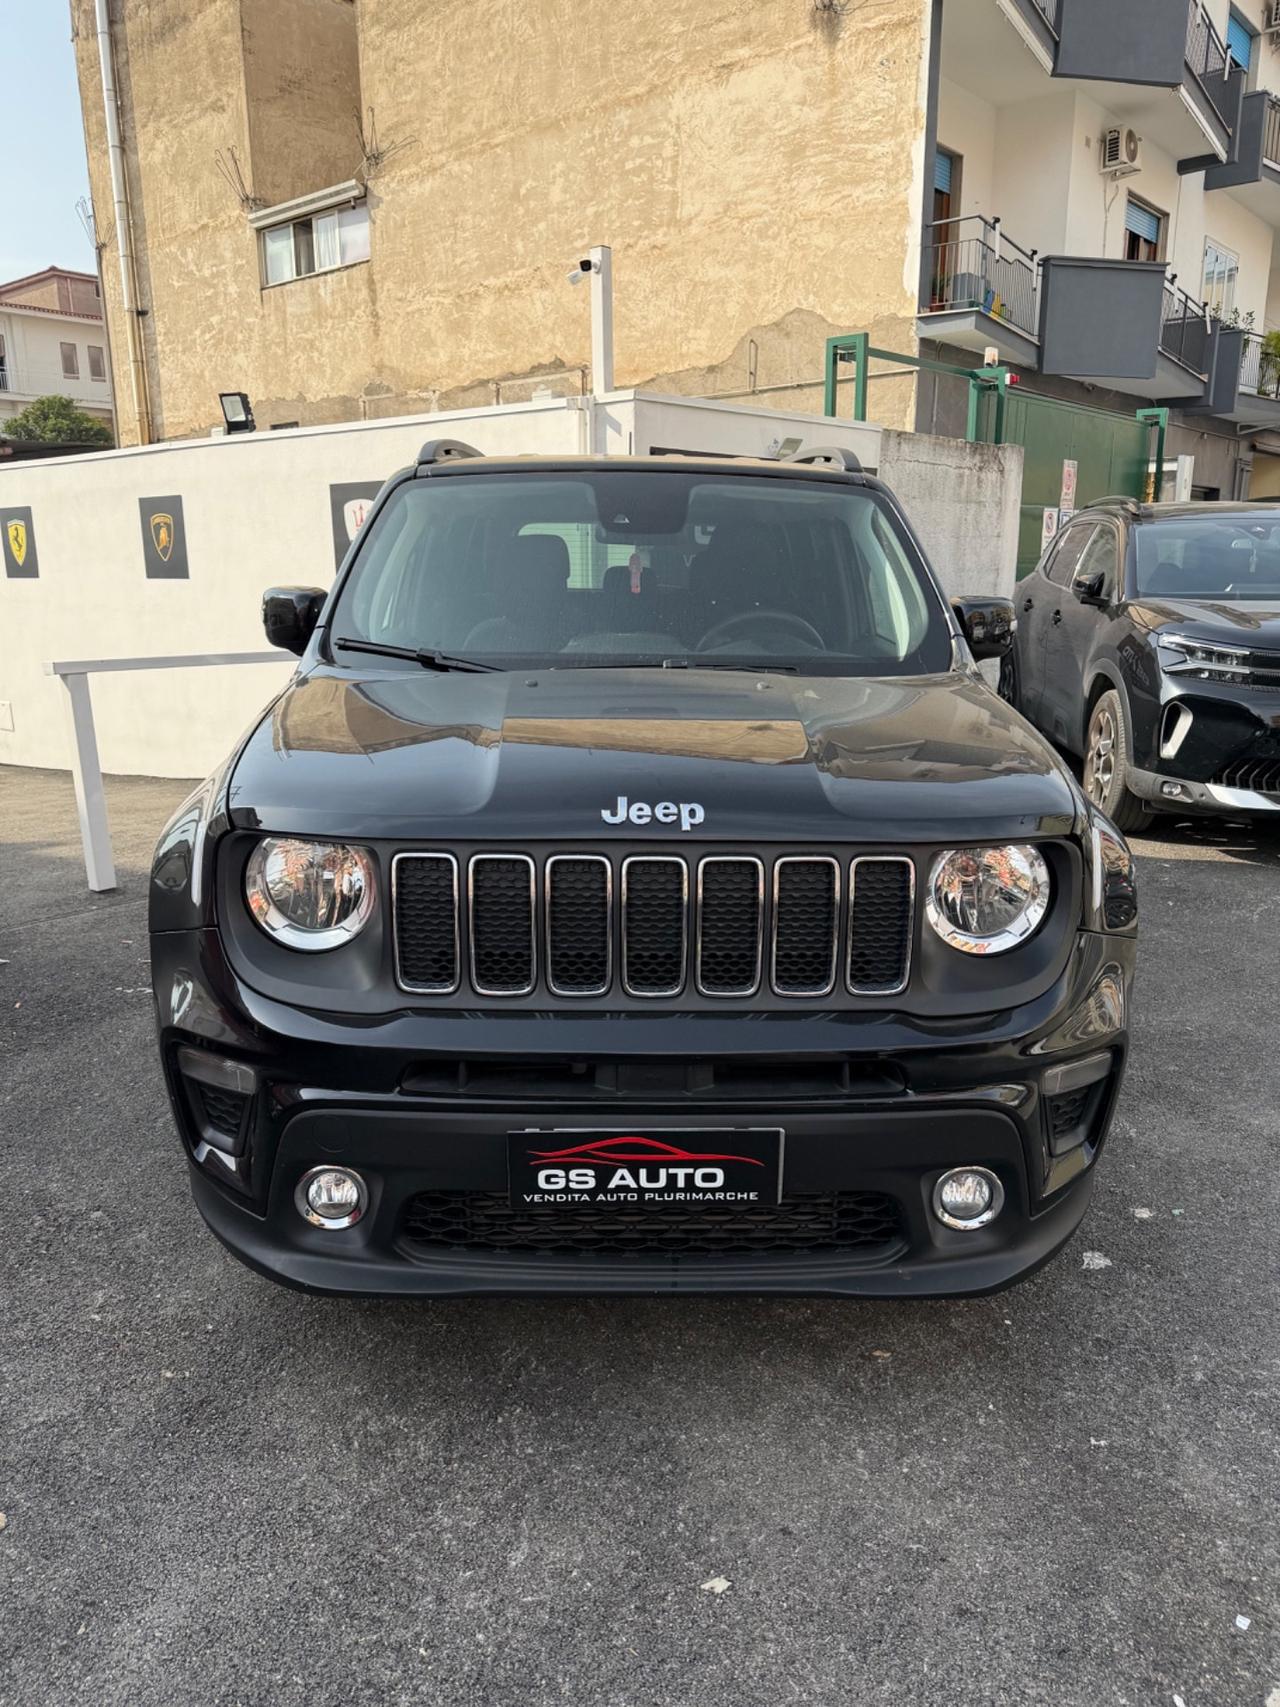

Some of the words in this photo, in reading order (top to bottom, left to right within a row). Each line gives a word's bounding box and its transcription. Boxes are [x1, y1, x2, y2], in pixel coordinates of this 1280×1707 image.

[601, 796, 705, 831] Jeep
[537, 1168, 596, 1190] GS
[607, 1167, 725, 1189] AUTO
[523, 1193, 591, 1203] VENDITA
[596, 1192, 638, 1202] AUTO
[644, 1191, 759, 1201] PLURIMARCHE
